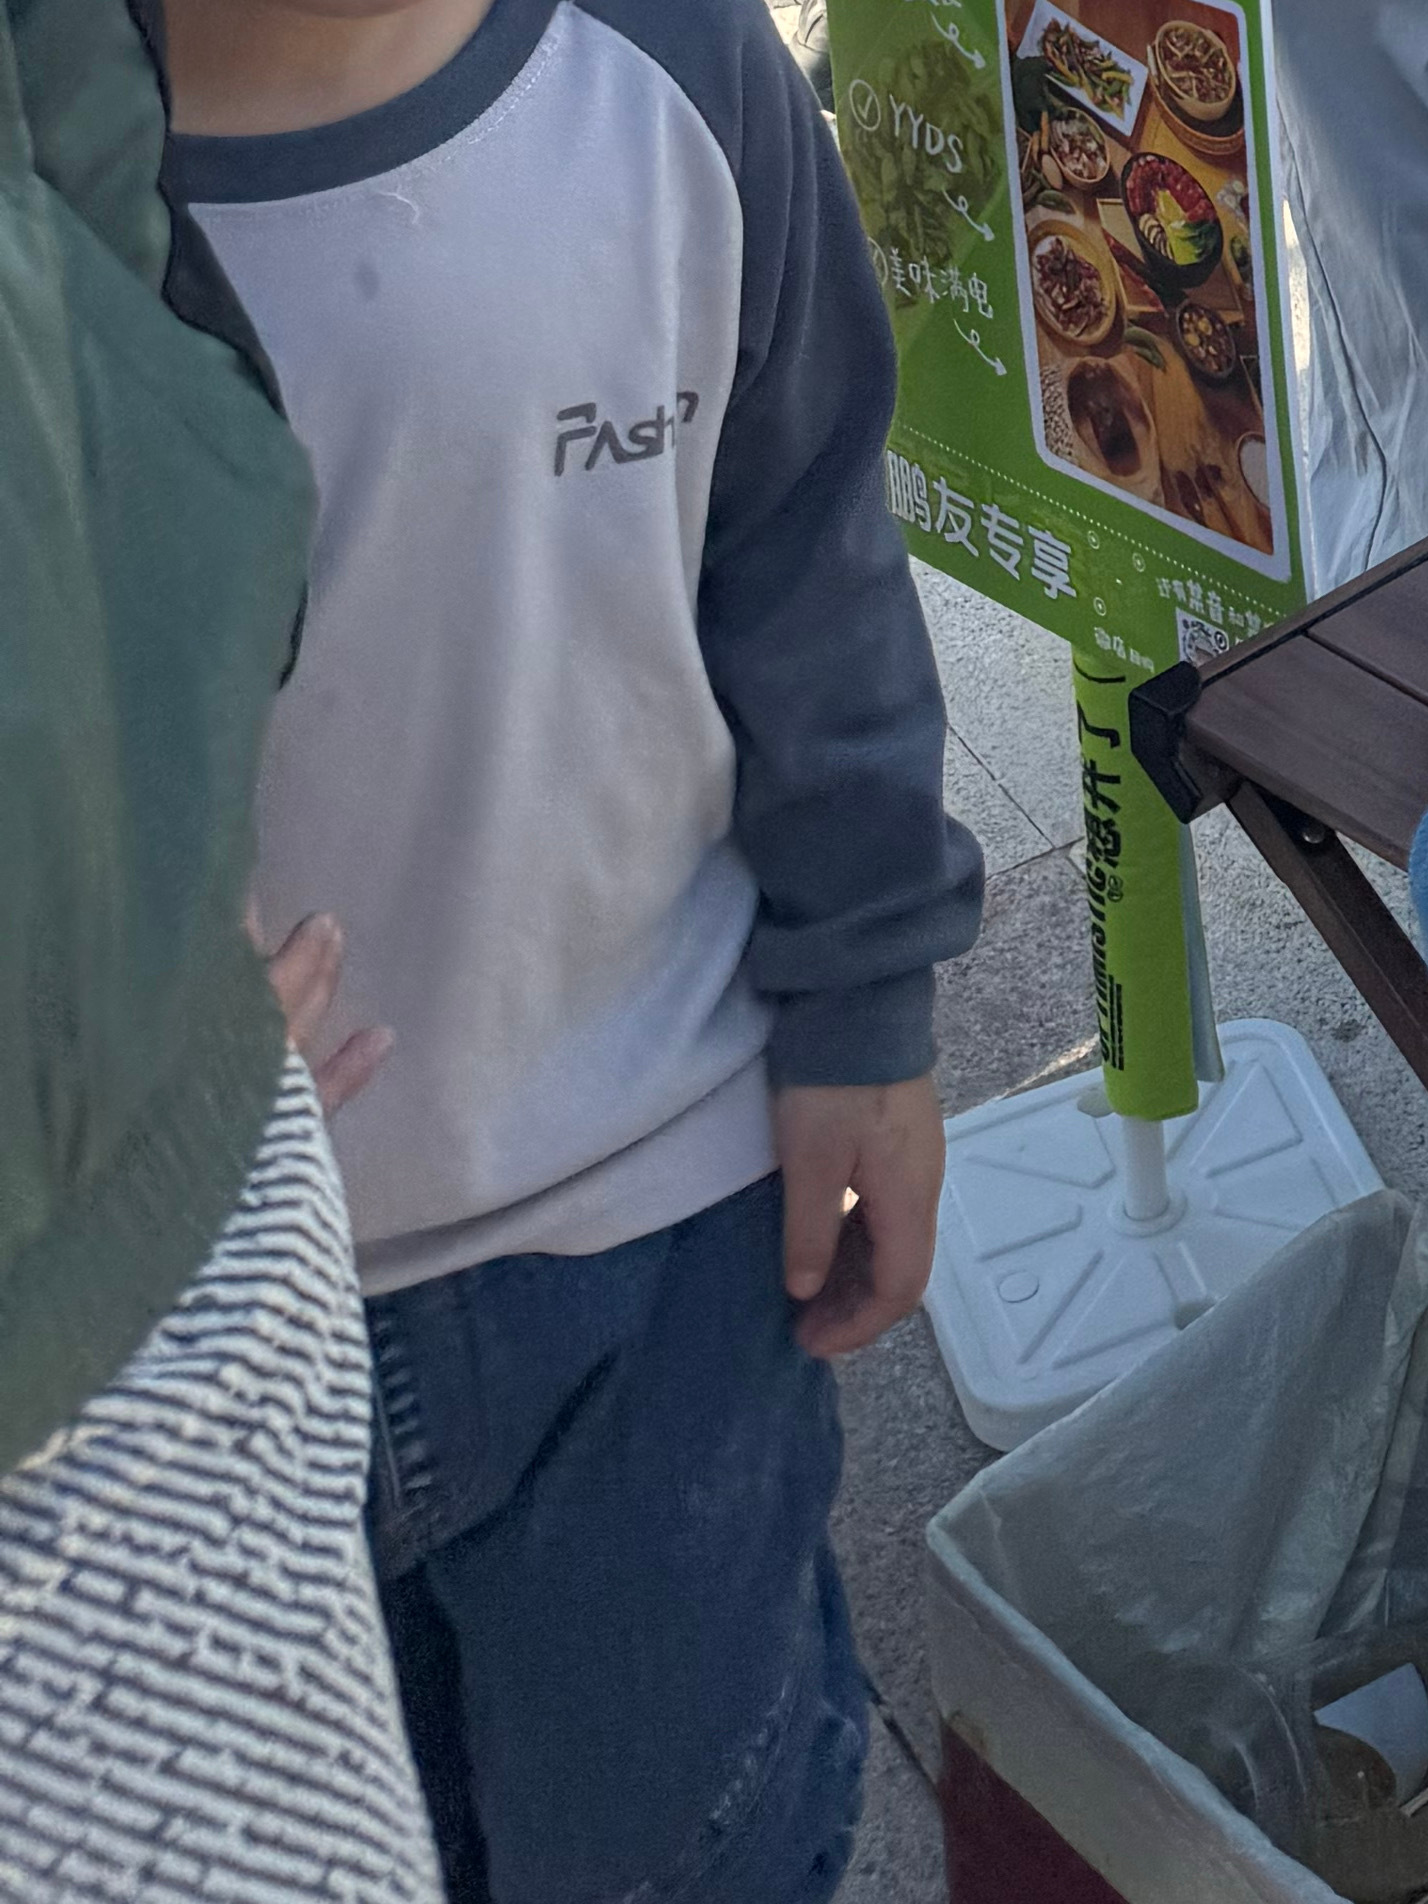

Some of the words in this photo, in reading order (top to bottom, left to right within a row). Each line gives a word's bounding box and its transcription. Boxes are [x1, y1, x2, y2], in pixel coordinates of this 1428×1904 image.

[889, 93, 964, 174] YYDS
[889, 248, 994, 319] 美味满电
[887, 447, 1077, 600] 鹏友专享
